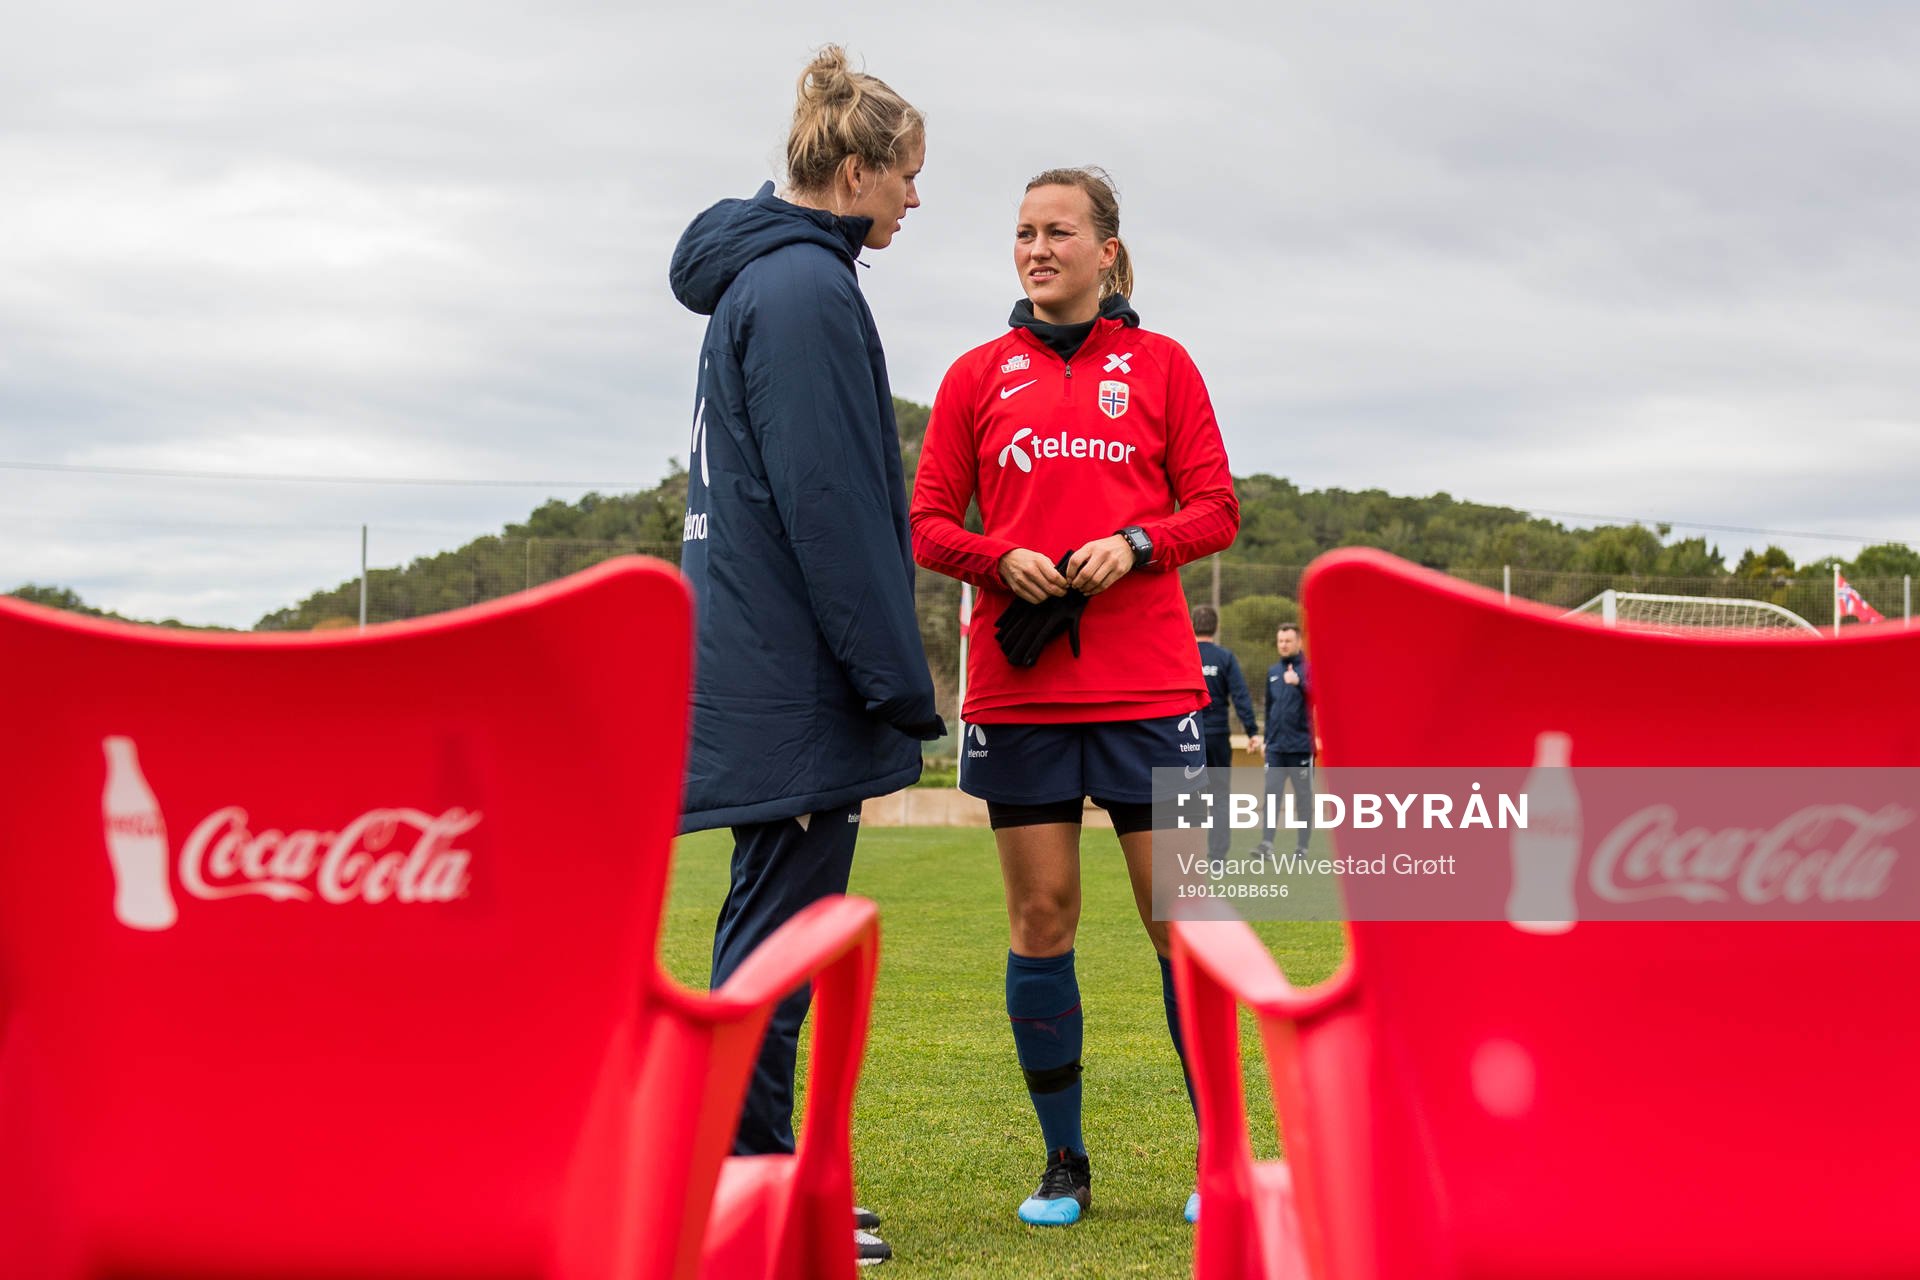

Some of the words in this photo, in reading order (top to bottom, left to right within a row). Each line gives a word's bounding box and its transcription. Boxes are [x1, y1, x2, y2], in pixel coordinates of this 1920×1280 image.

[1031, 431, 1136, 464] telenor
[178, 805, 484, 904] Coca-Cola
[1588, 802, 1917, 905] Coca-Cola
